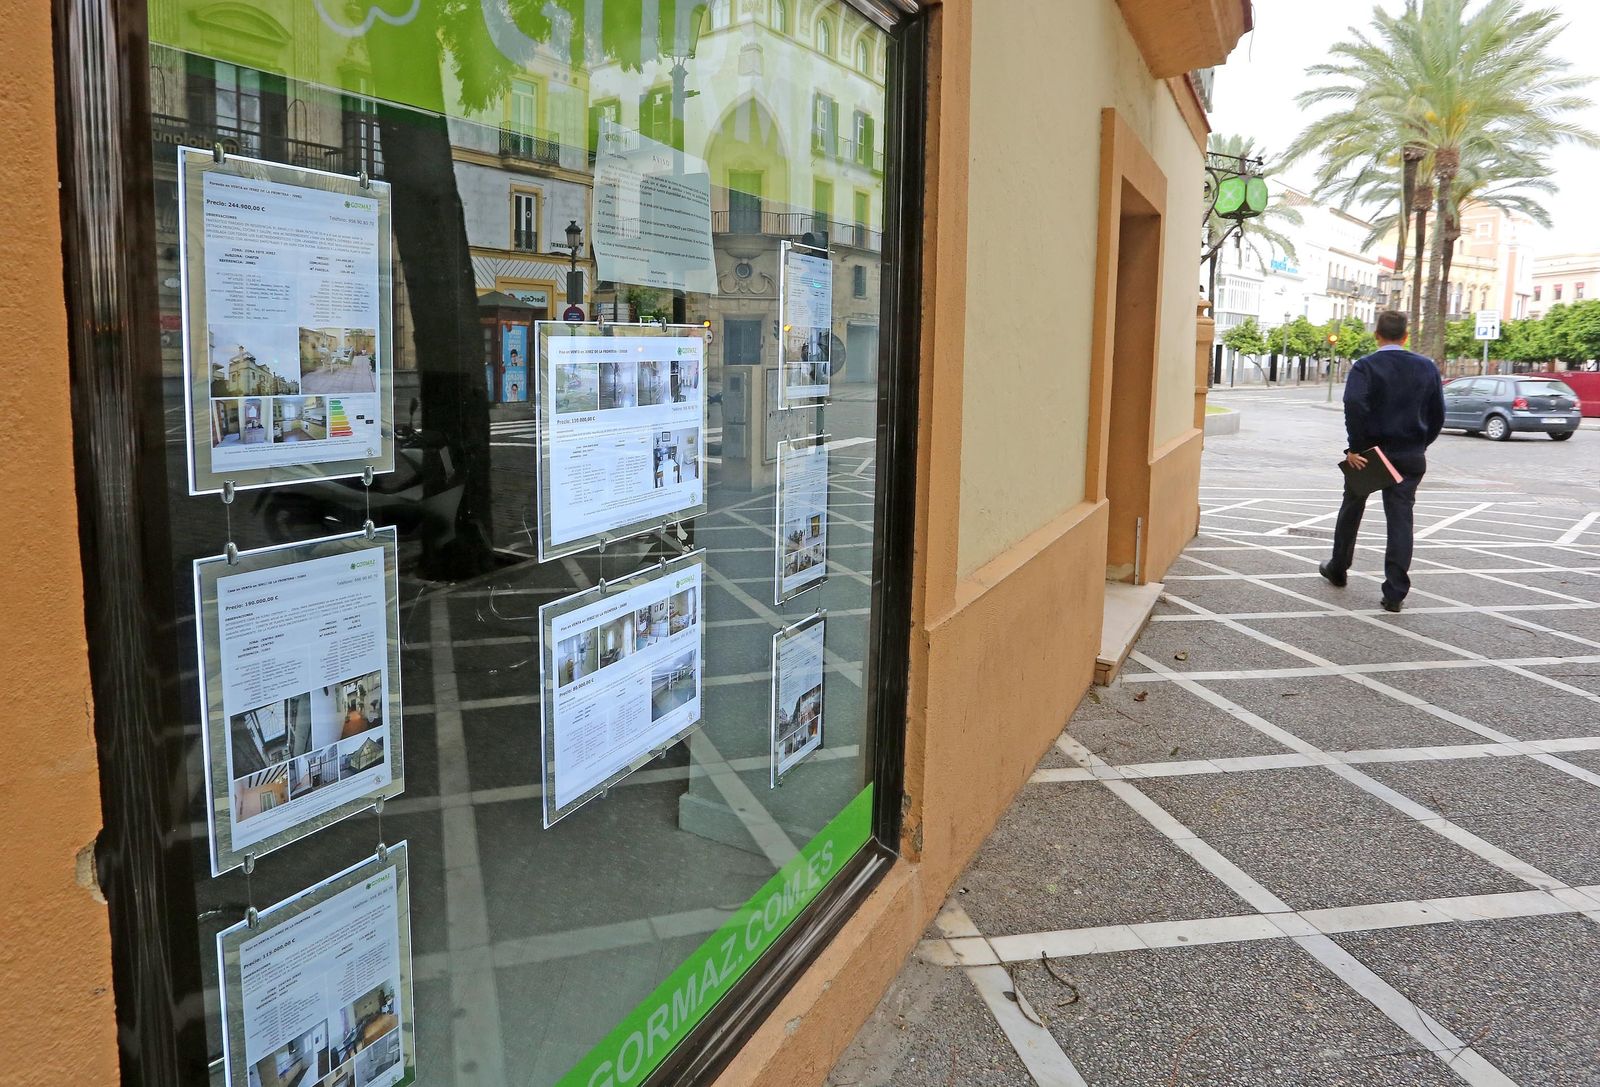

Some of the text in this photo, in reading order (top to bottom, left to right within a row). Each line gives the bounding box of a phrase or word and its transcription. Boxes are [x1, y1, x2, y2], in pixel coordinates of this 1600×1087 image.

[207, 199, 226, 207] Precio:
[228, 202, 260, 212] 244.900,00
[225, 603, 243, 611] Precio:
[245, 596, 274, 607] 190.000,00
[243, 958, 261, 970] Precio:
[587, 840, 833, 1087] GORMAZ.COM.ES
